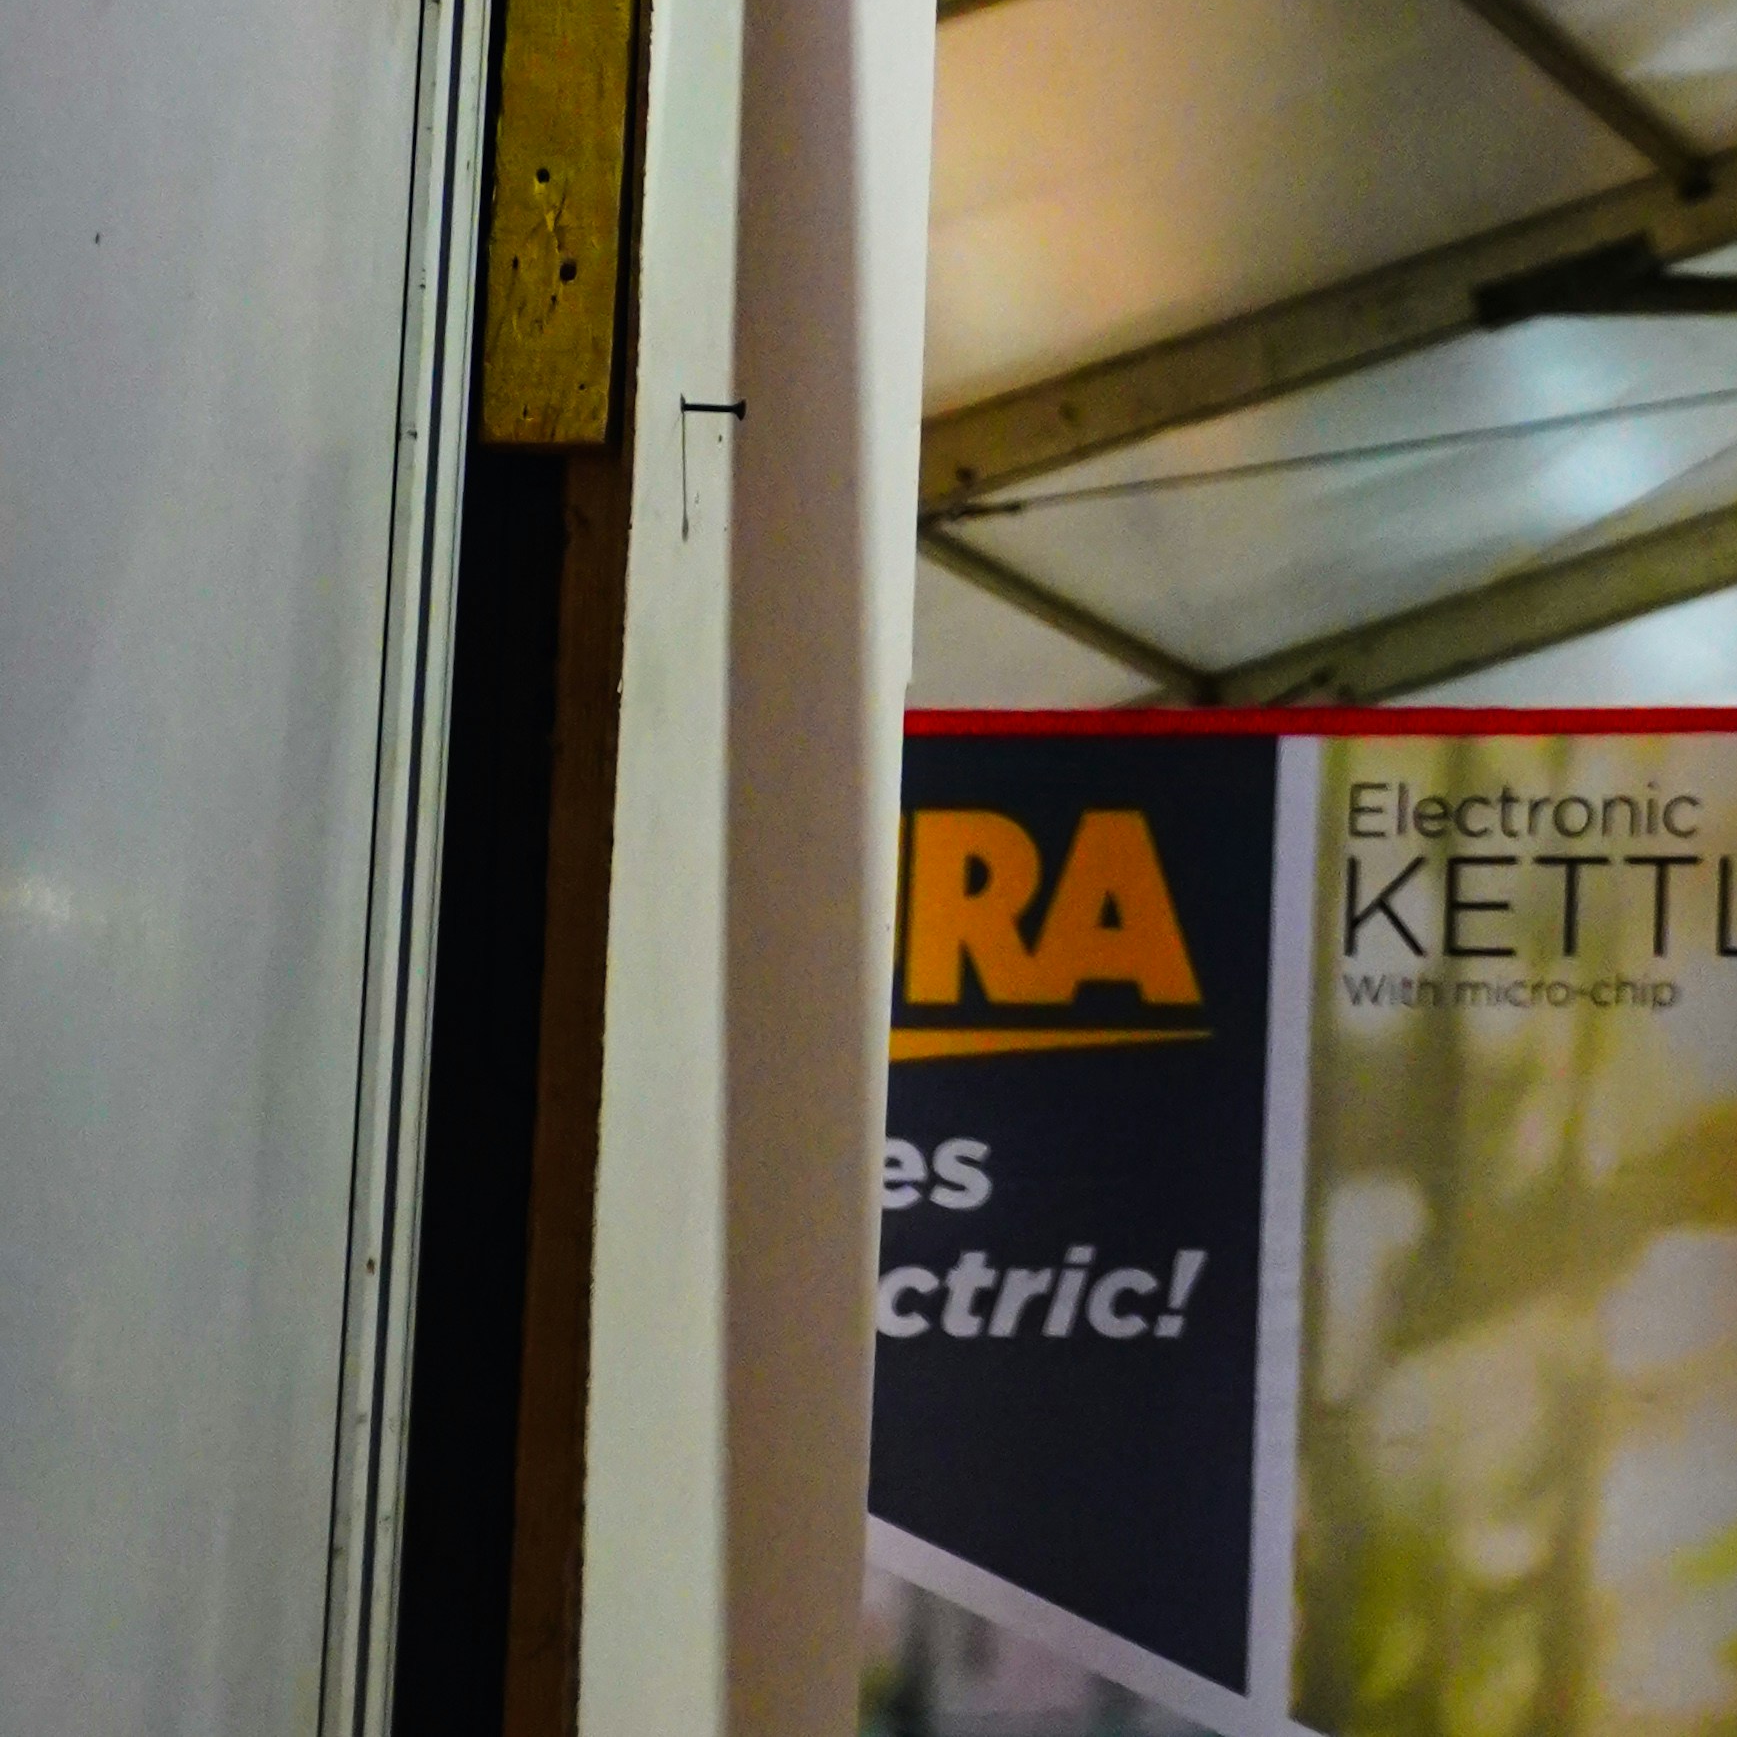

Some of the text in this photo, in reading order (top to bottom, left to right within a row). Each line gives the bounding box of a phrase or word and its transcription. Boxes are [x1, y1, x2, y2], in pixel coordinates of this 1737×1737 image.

[1346, 781, 1701, 839] Electronic
[893, 807, 1203, 1006] RA
[1342, 973, 1682, 1012] With micro-chip
